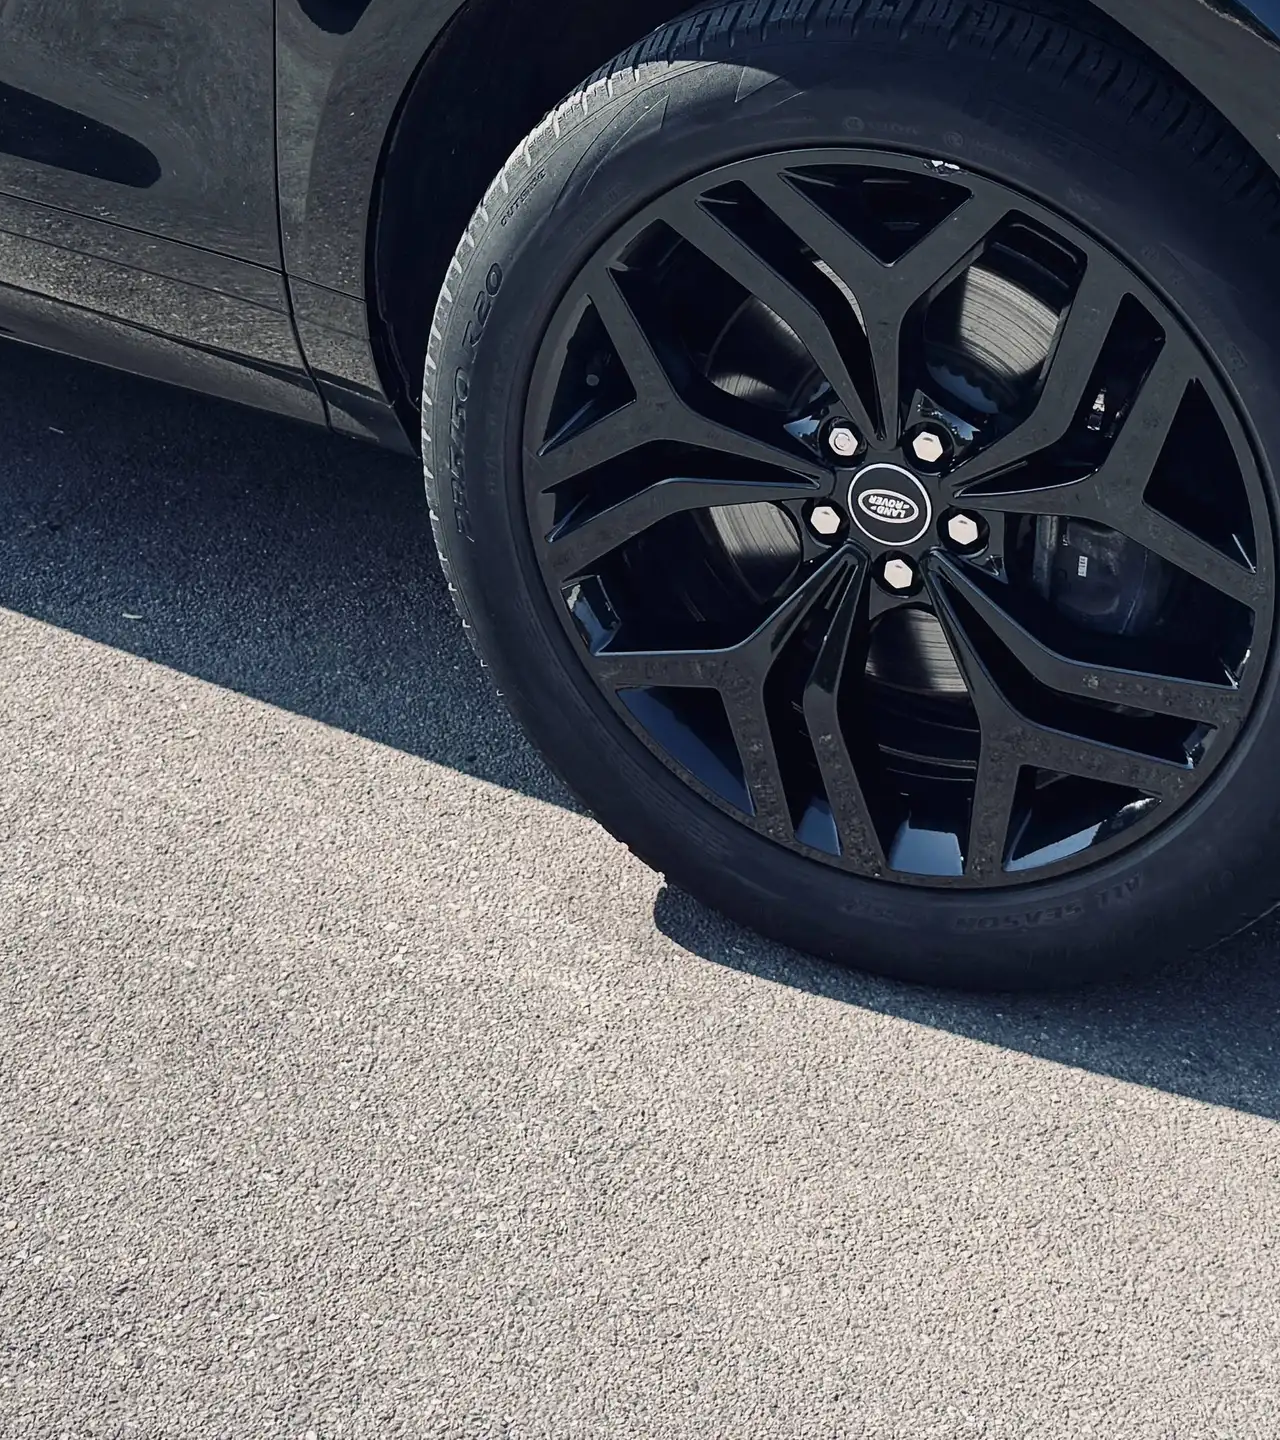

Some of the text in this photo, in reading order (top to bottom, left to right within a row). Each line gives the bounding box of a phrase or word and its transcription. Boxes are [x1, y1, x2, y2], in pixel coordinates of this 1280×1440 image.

[868, 494, 904, 510] ROVER
[876, 505, 906, 518] LAND
[953, 900, 1085, 931] SEASON
